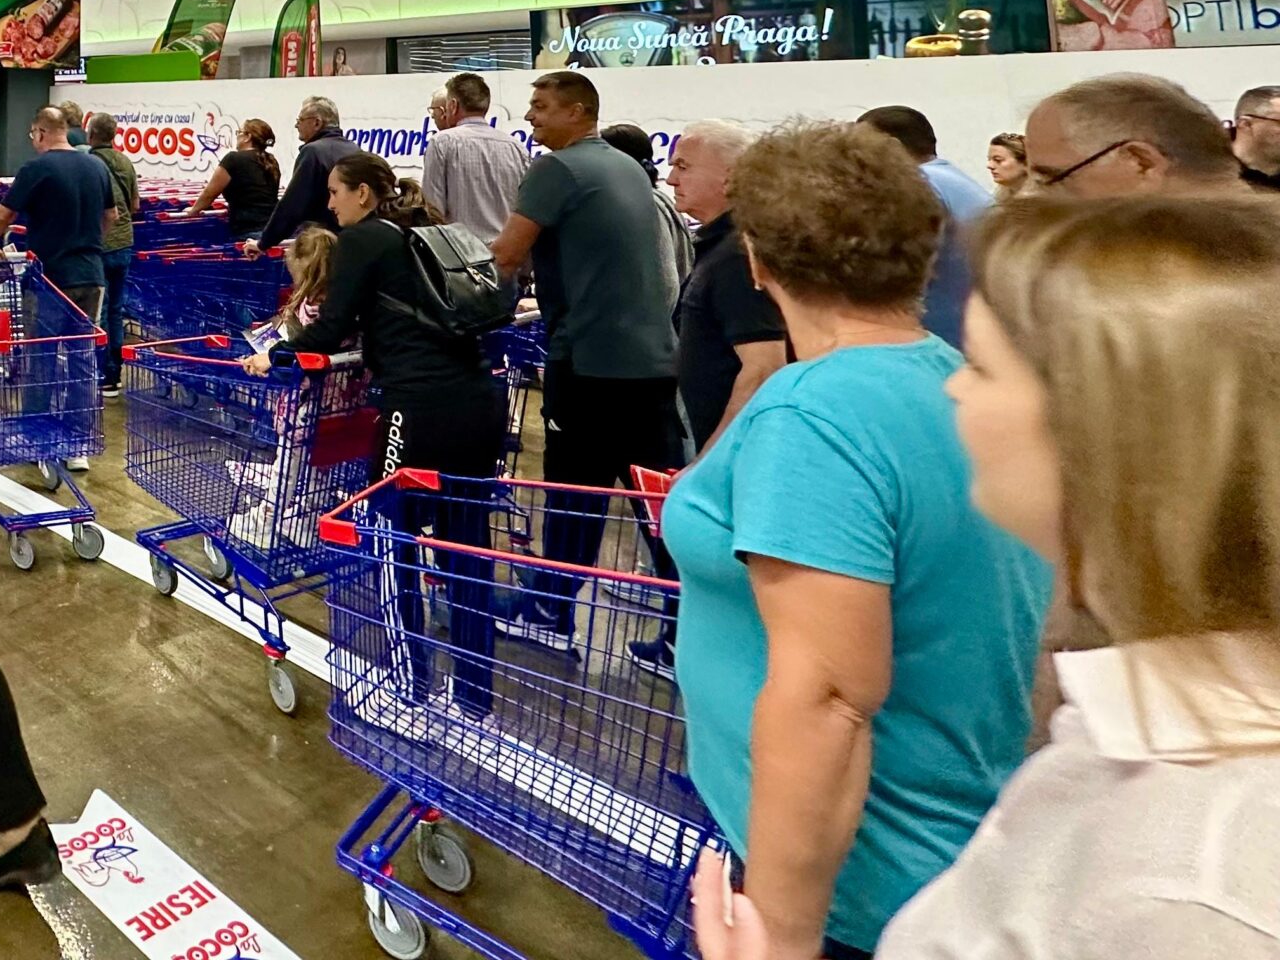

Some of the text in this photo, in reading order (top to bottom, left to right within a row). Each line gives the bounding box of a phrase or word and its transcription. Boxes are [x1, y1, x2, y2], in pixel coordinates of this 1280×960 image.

[548, 25, 622, 54] Noua
[112, 111, 140, 126] marketul
[174, 114, 190, 124] casa
[124, 880, 218, 942] IESIRE
